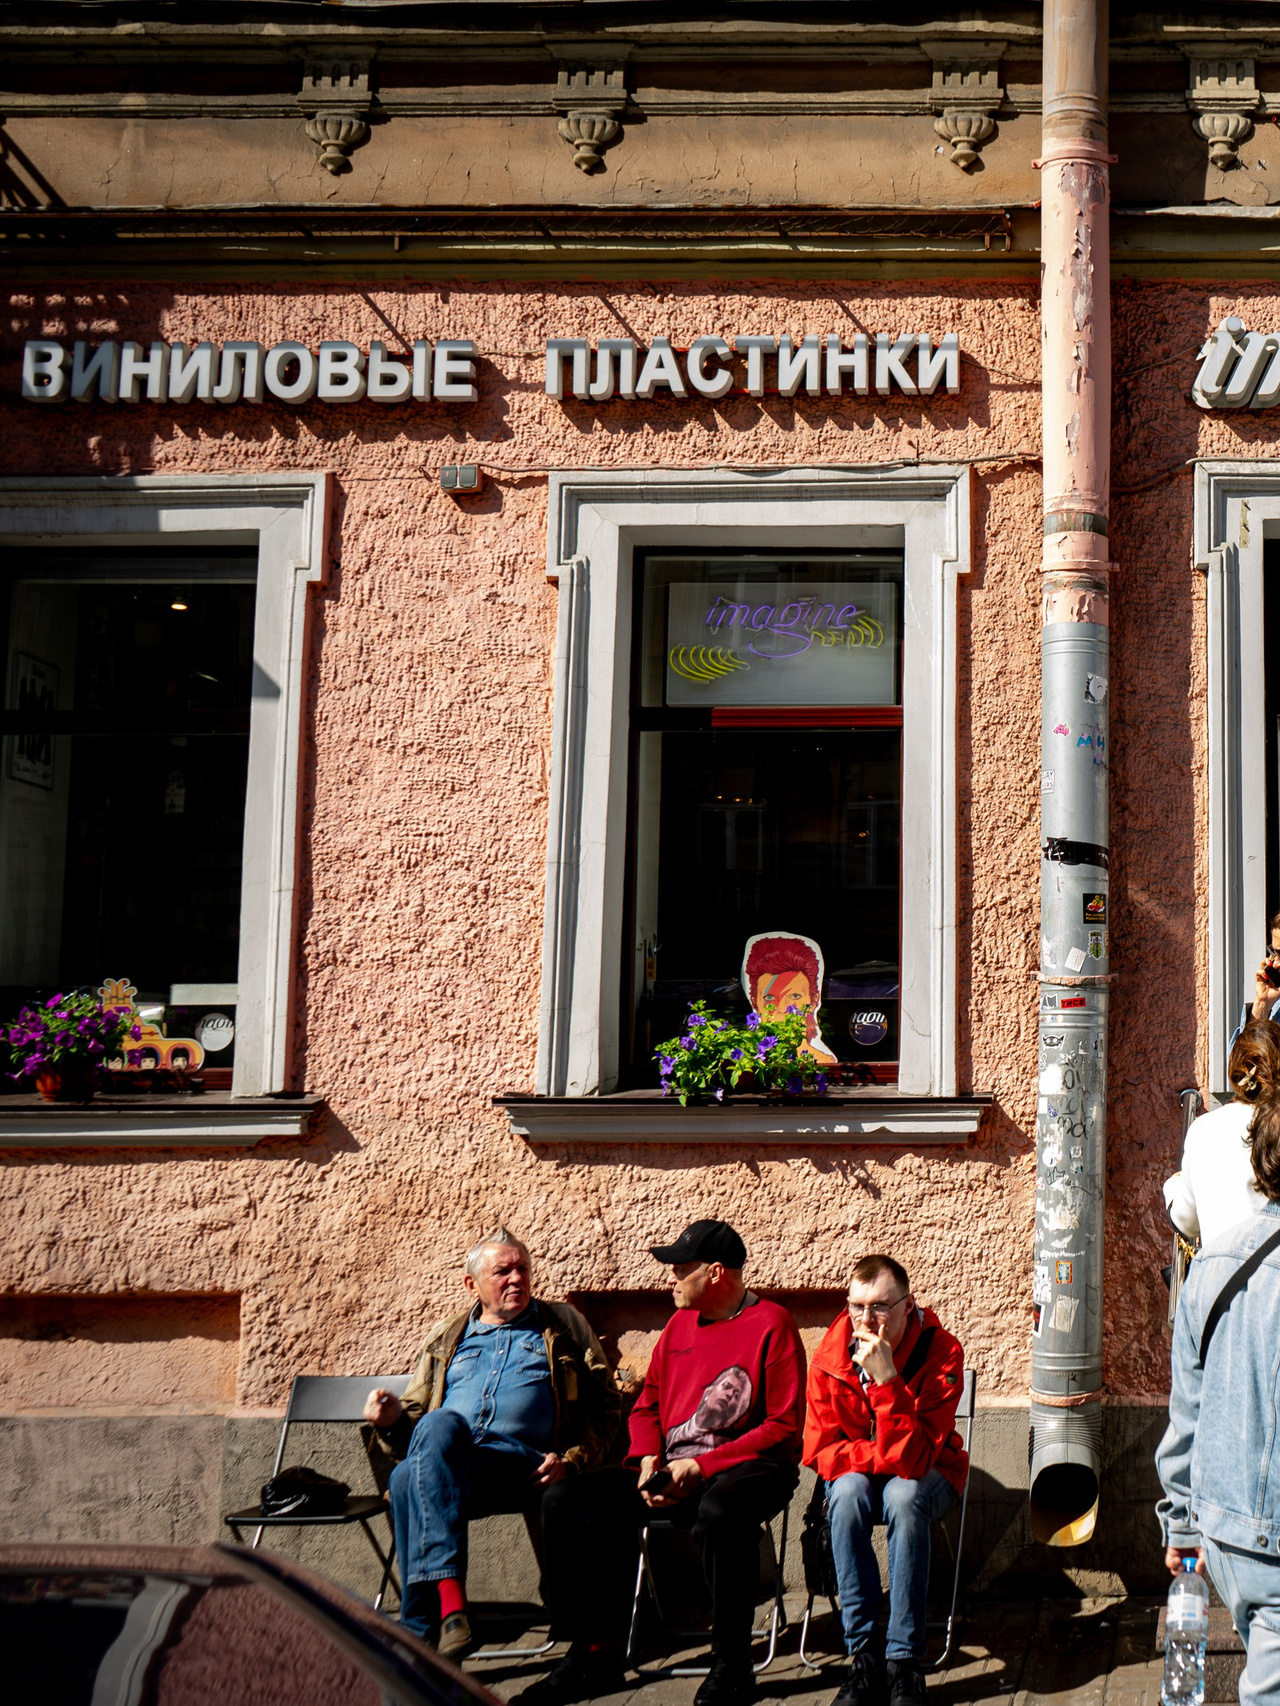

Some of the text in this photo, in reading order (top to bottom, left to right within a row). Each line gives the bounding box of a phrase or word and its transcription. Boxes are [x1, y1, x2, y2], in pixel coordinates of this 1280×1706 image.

[22, 333, 960, 404] ВИНИЛОВЫЕ ПЛАСТИНКИ
[705, 595, 857, 658] imagine
